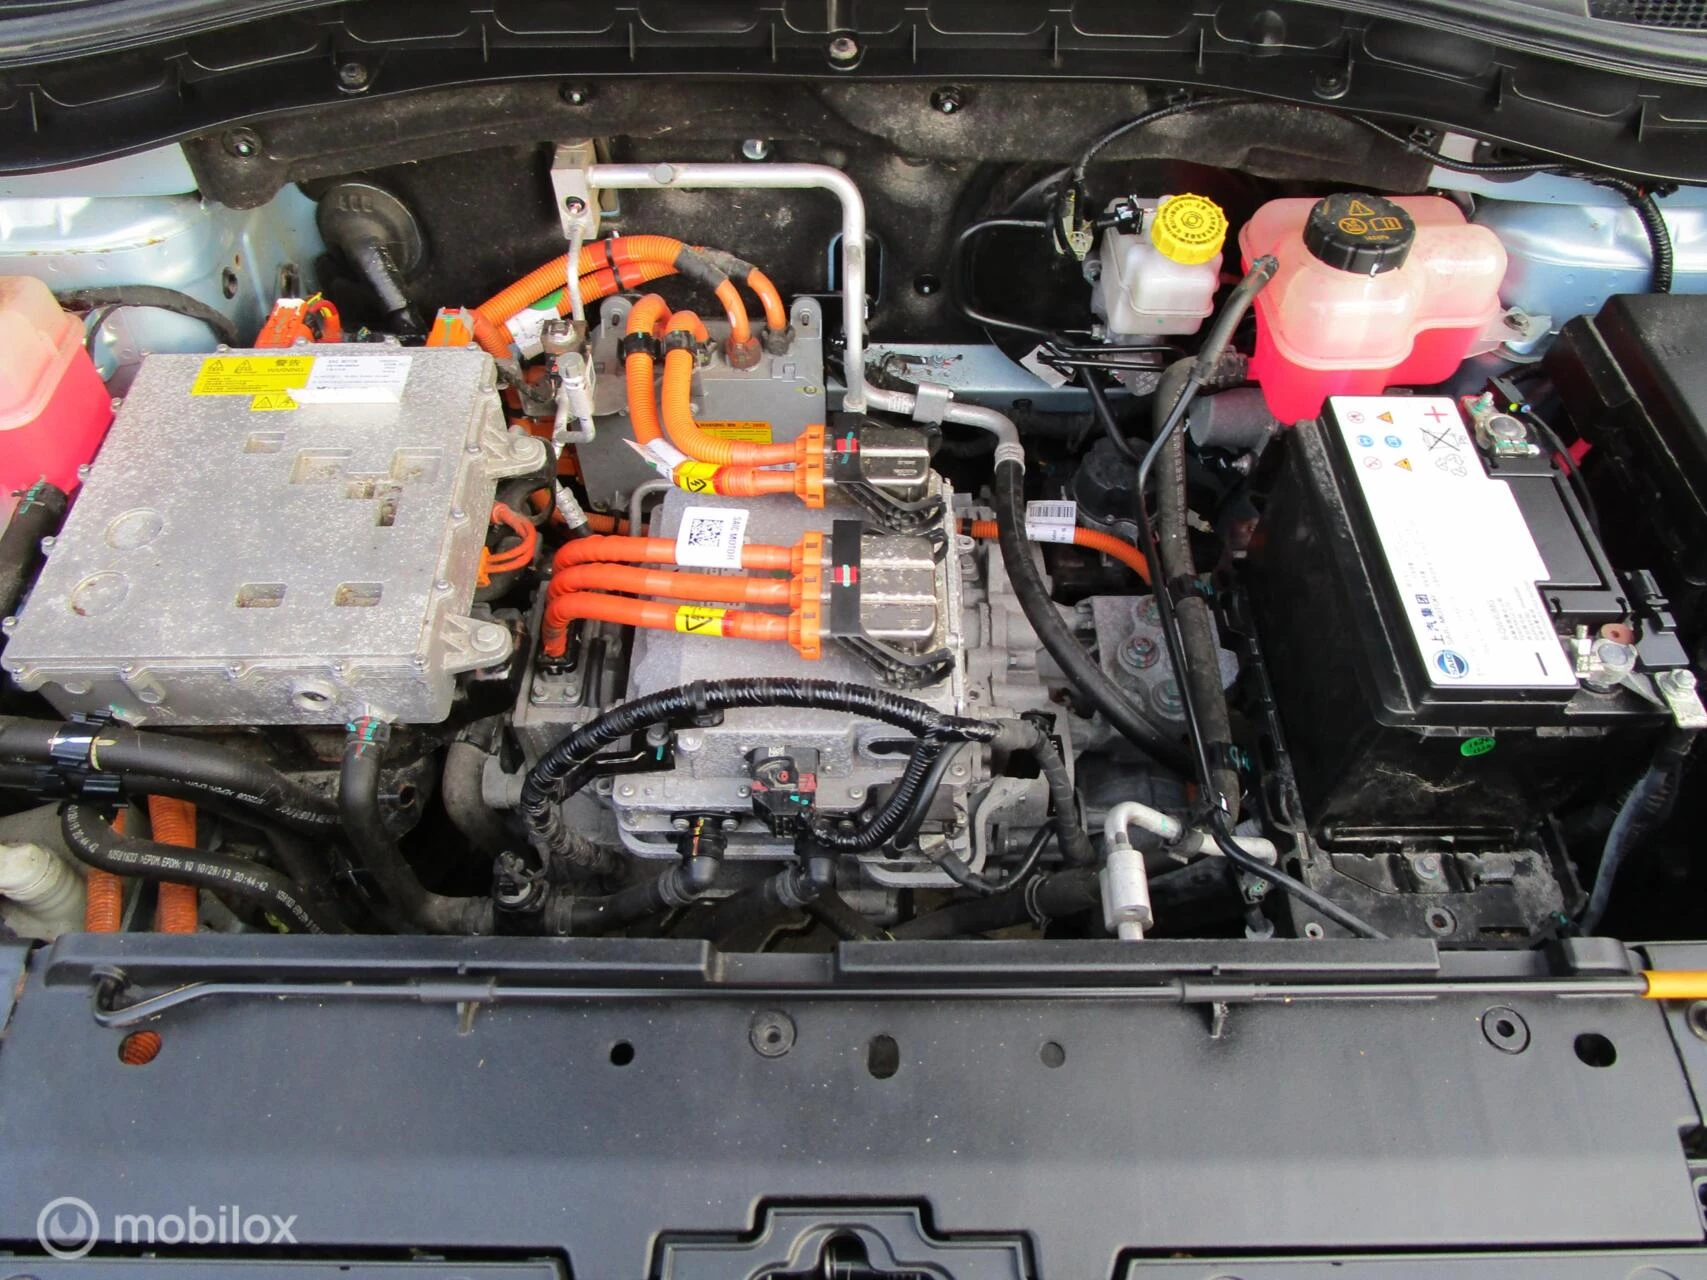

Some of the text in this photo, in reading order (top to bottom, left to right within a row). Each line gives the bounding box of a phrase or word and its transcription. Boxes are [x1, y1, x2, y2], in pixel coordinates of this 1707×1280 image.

[727, 516, 742, 560] SAIC MOTOR
[1415, 593, 1446, 645] 上汽集团
